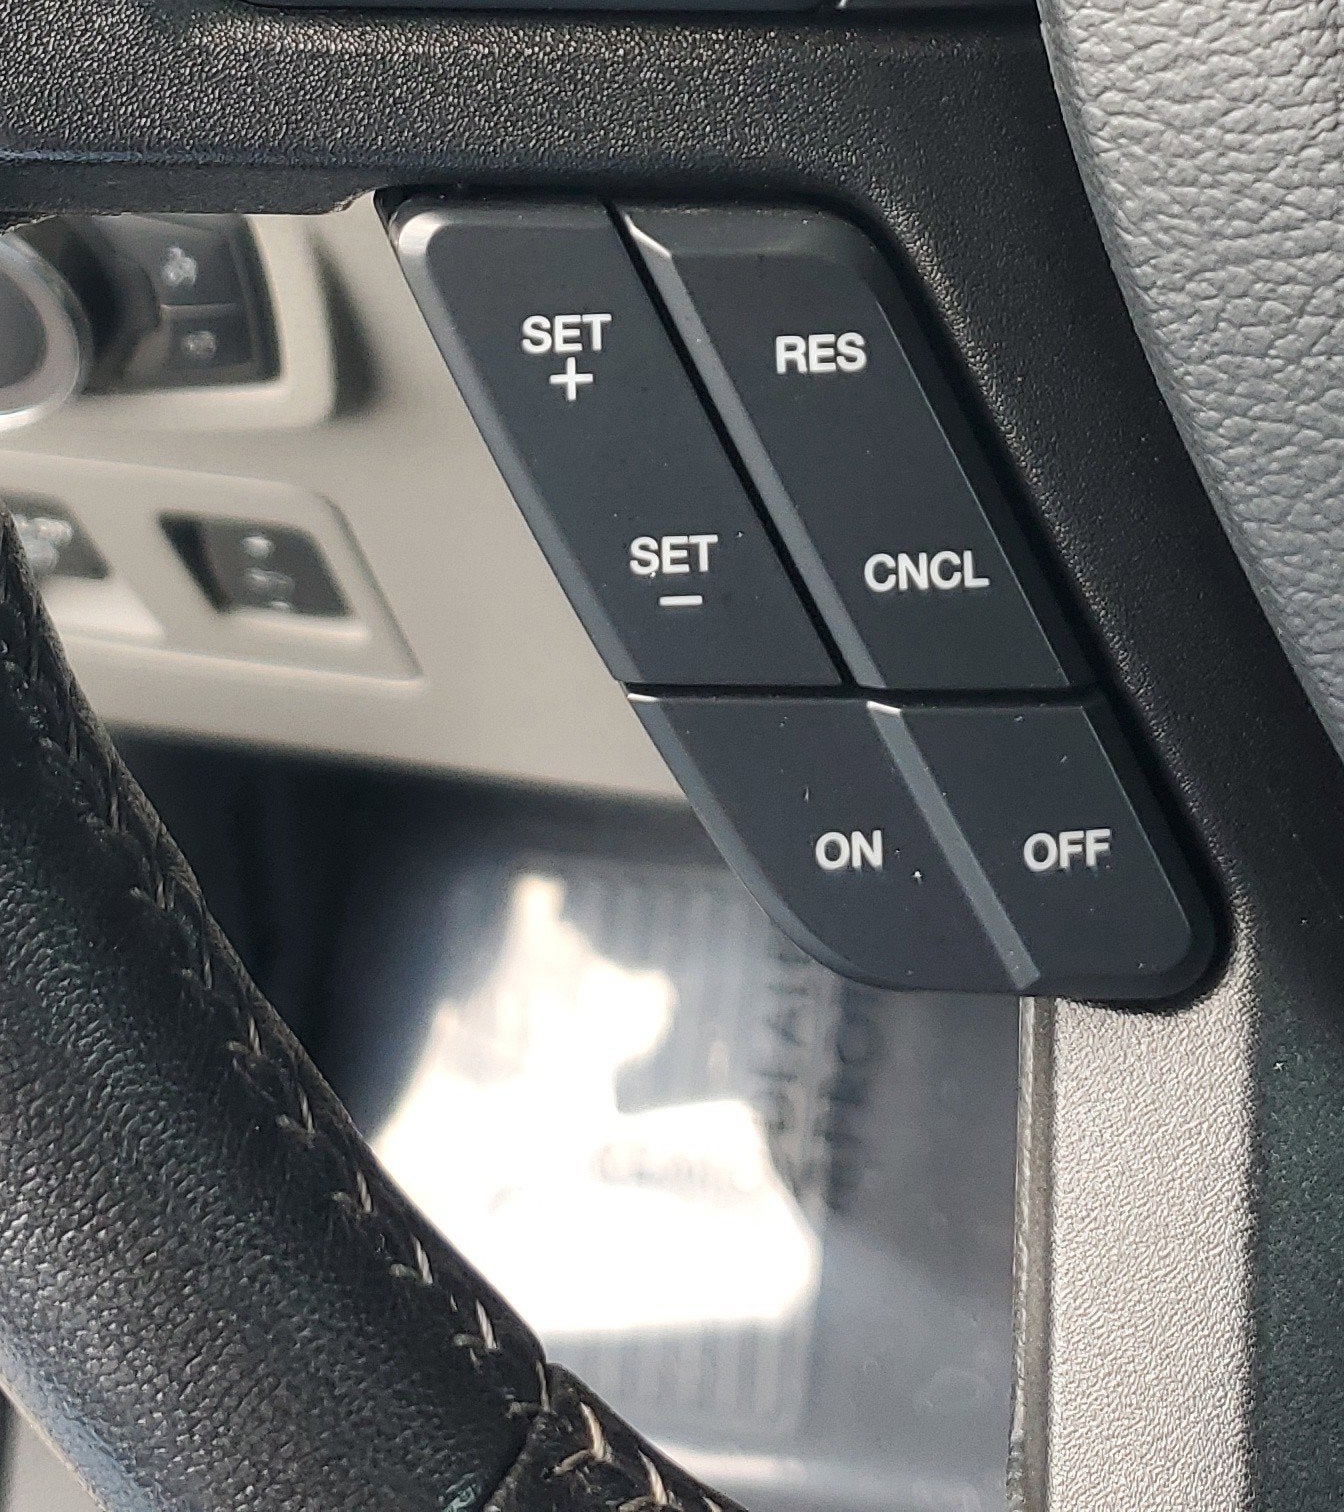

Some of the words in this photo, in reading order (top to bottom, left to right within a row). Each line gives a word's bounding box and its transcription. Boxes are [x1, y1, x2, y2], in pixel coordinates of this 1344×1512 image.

[521, 313, 612, 353] SET
[775, 332, 867, 373] RES
[629, 534, 718, 576] SET
[863, 550, 990, 593] CNCL
[814, 830, 884, 871] ON
[1022, 828, 1111, 872] OFF
